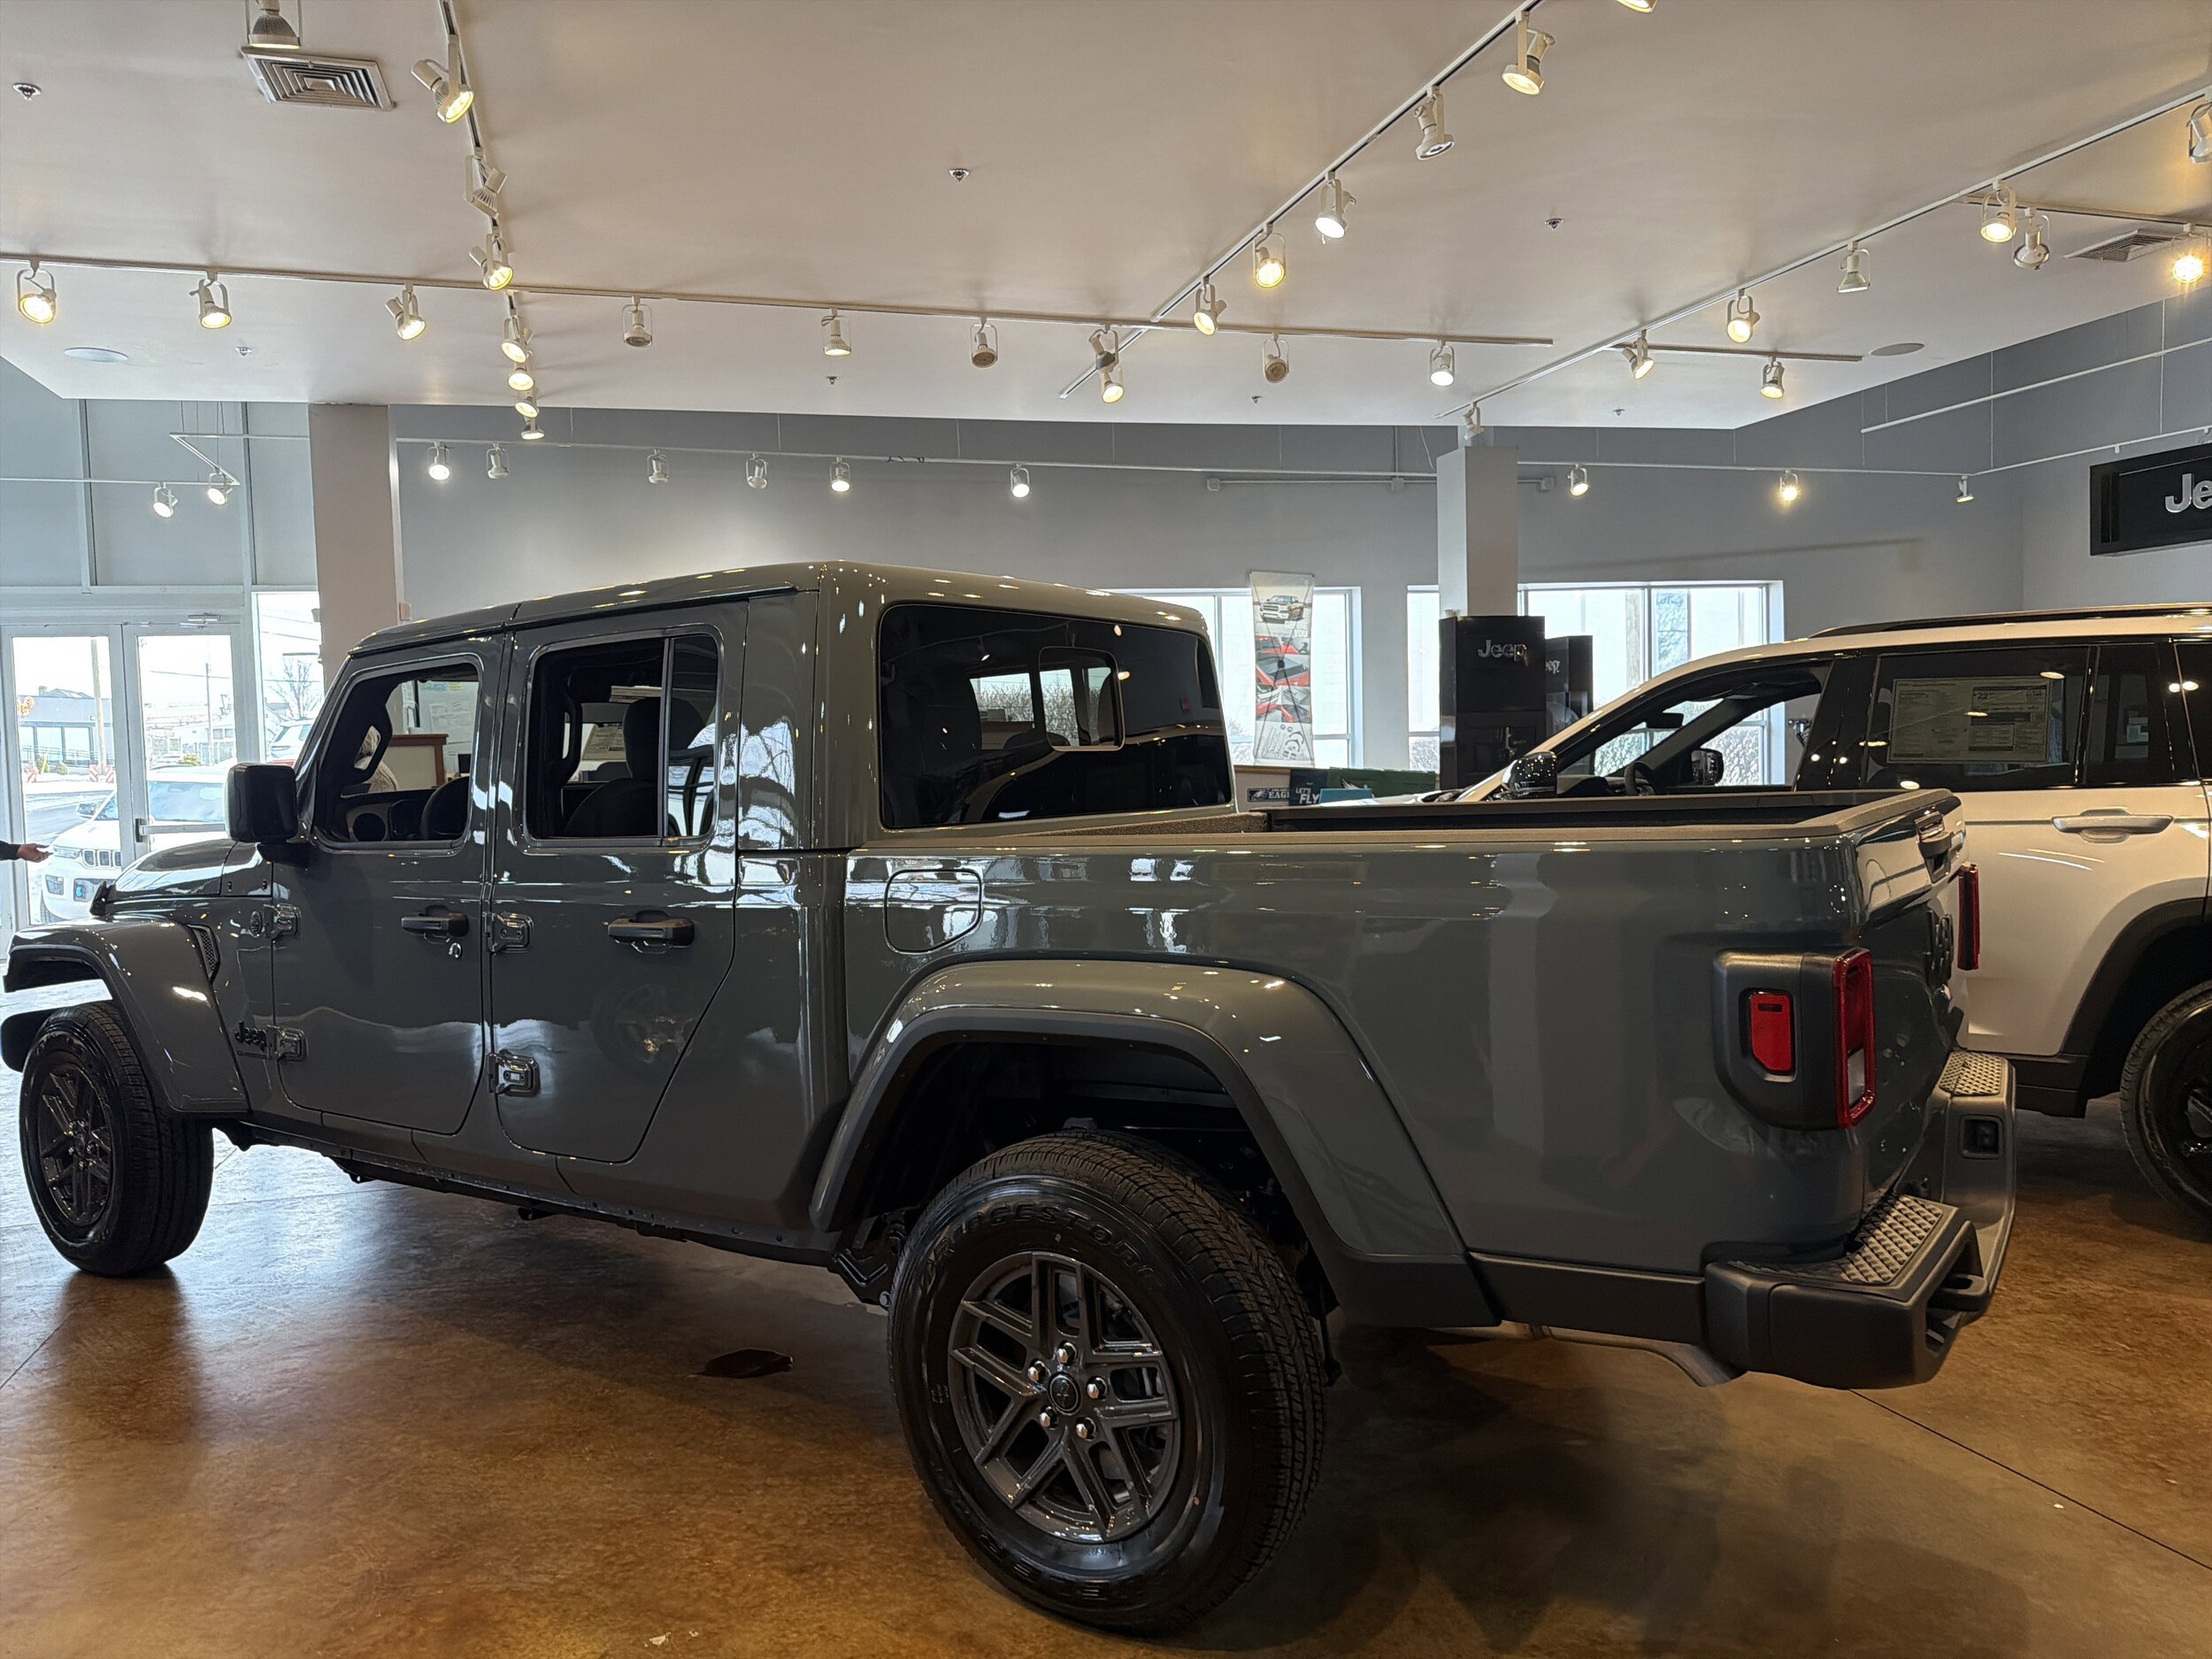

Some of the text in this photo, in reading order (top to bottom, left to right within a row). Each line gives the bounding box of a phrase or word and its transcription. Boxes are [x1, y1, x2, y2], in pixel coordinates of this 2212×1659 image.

[1294, 629, 1309, 638] YOU
[1477, 639, 1526, 662] Jeep
[1299, 794, 1320, 804] FLY
[234, 1020, 268, 1051] Jeep
